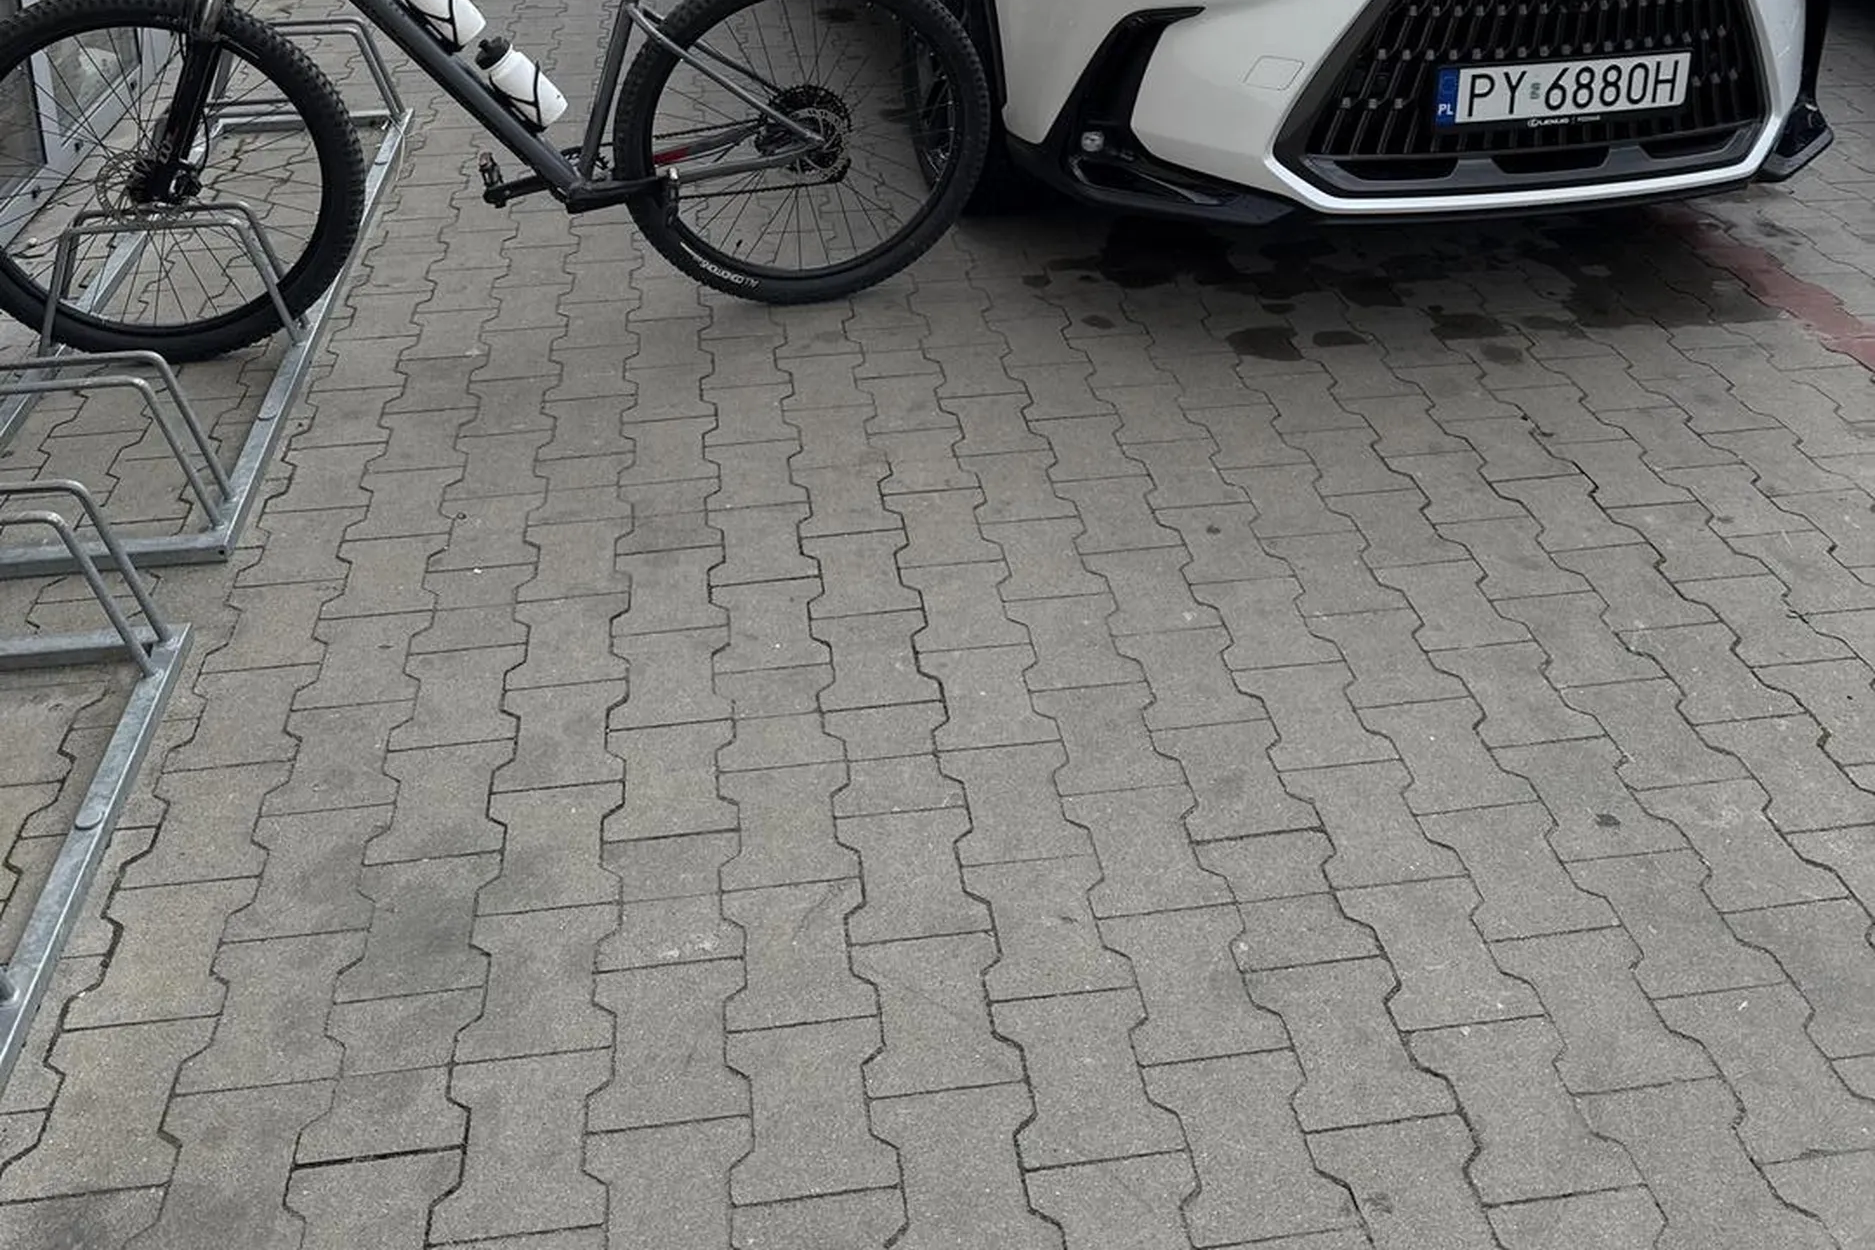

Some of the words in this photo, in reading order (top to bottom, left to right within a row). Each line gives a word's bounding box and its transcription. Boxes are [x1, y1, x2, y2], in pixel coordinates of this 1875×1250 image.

[1468, 71, 1527, 117] PY
[1544, 59, 1680, 111] 6880H
[1437, 103, 1454, 116] PL
